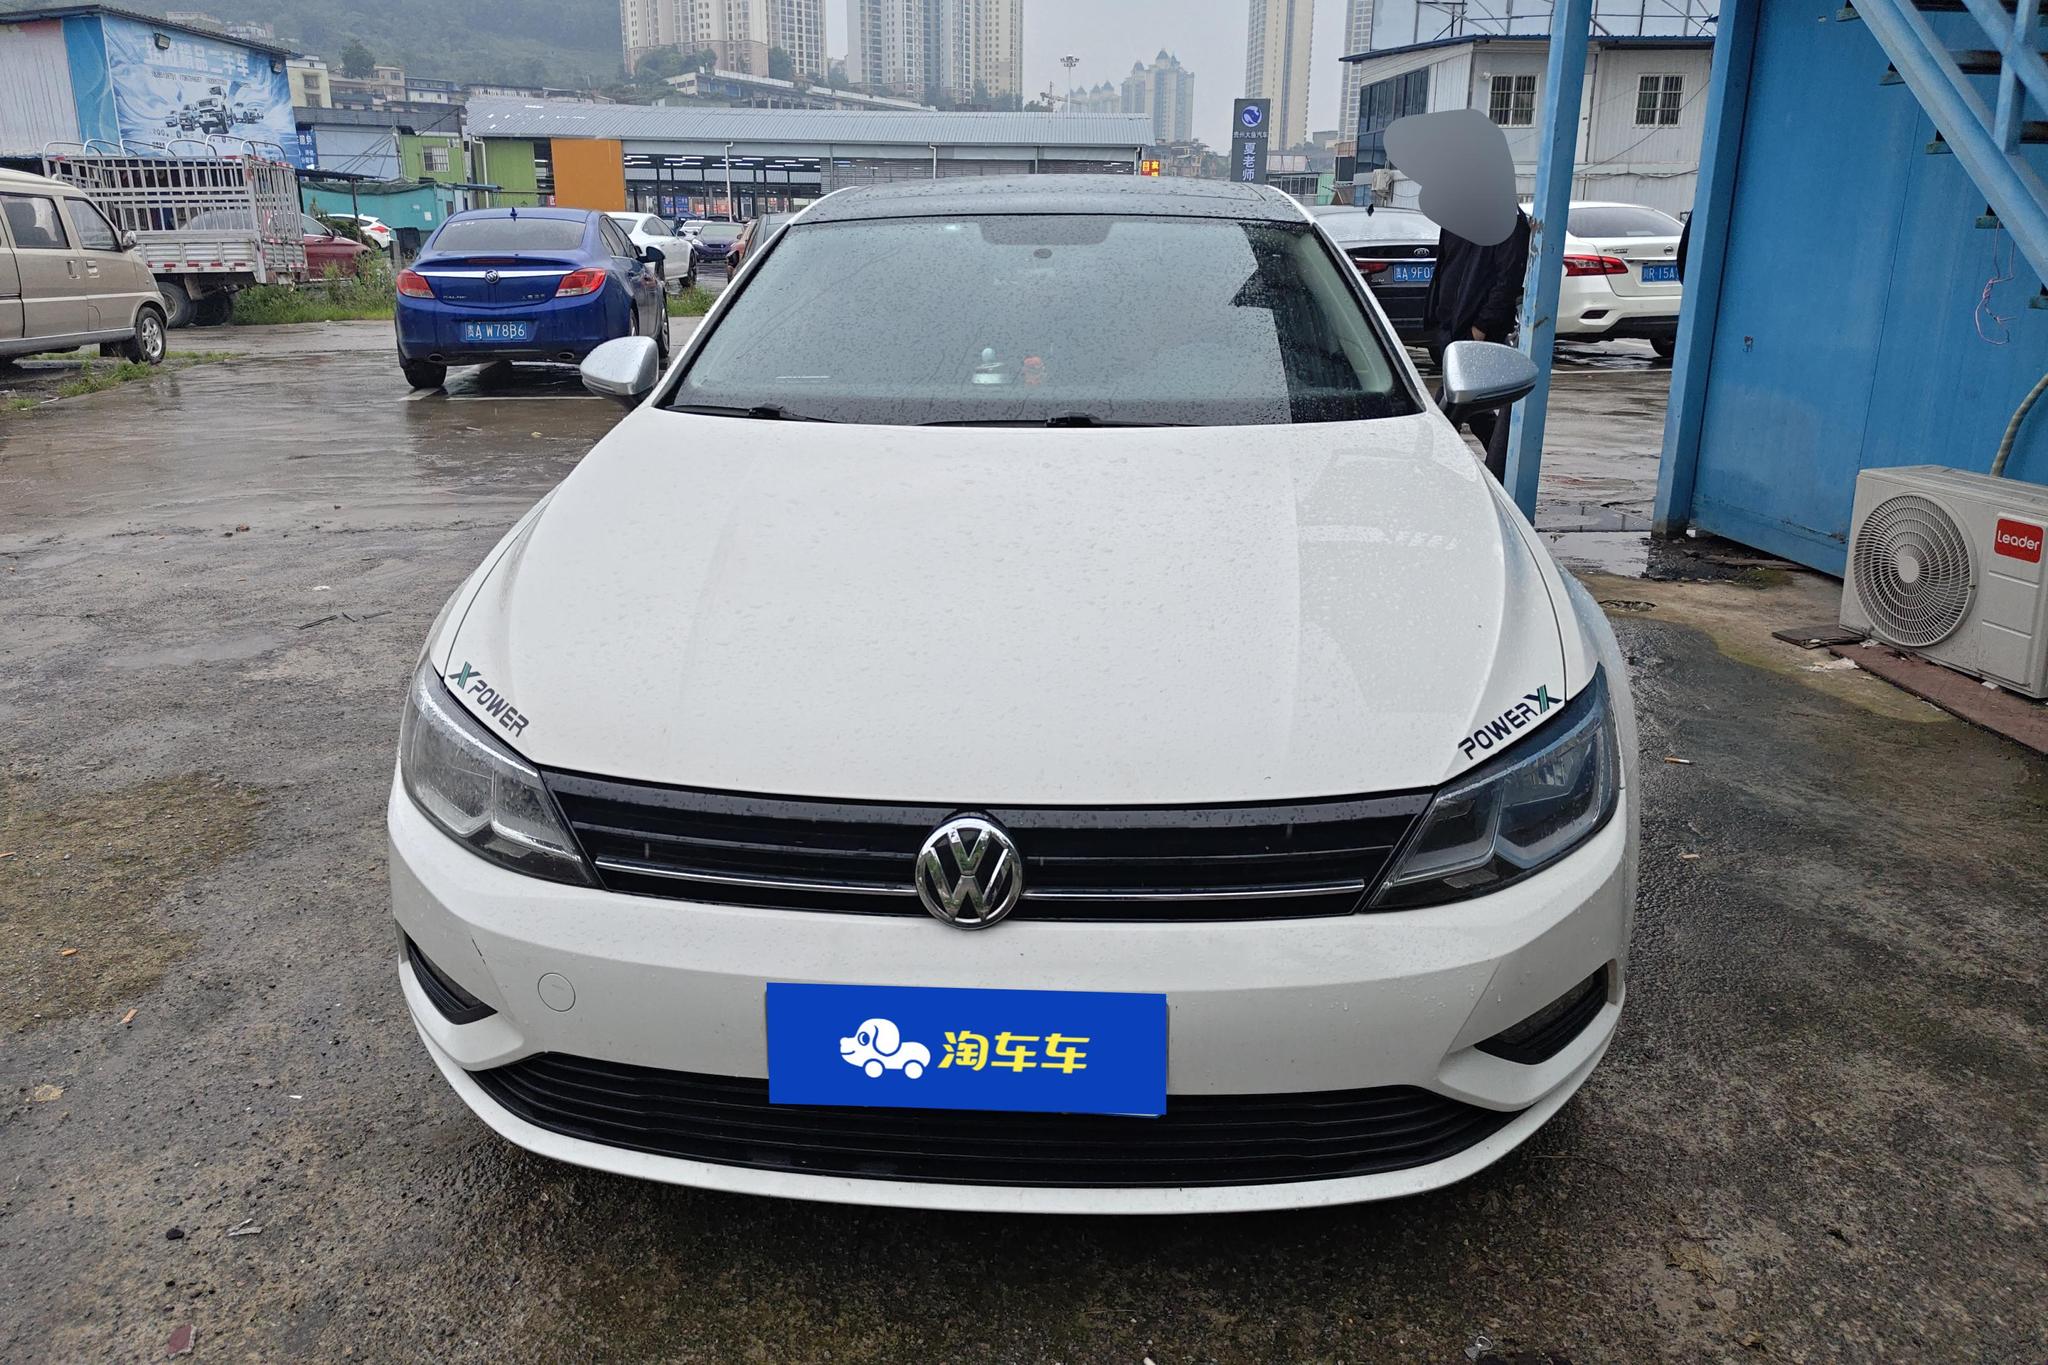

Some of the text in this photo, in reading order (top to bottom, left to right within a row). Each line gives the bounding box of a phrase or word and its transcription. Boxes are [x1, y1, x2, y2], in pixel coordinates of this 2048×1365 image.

[1242, 142, 1257, 182] 夏老师
[1997, 529, 2040, 551] Leader
